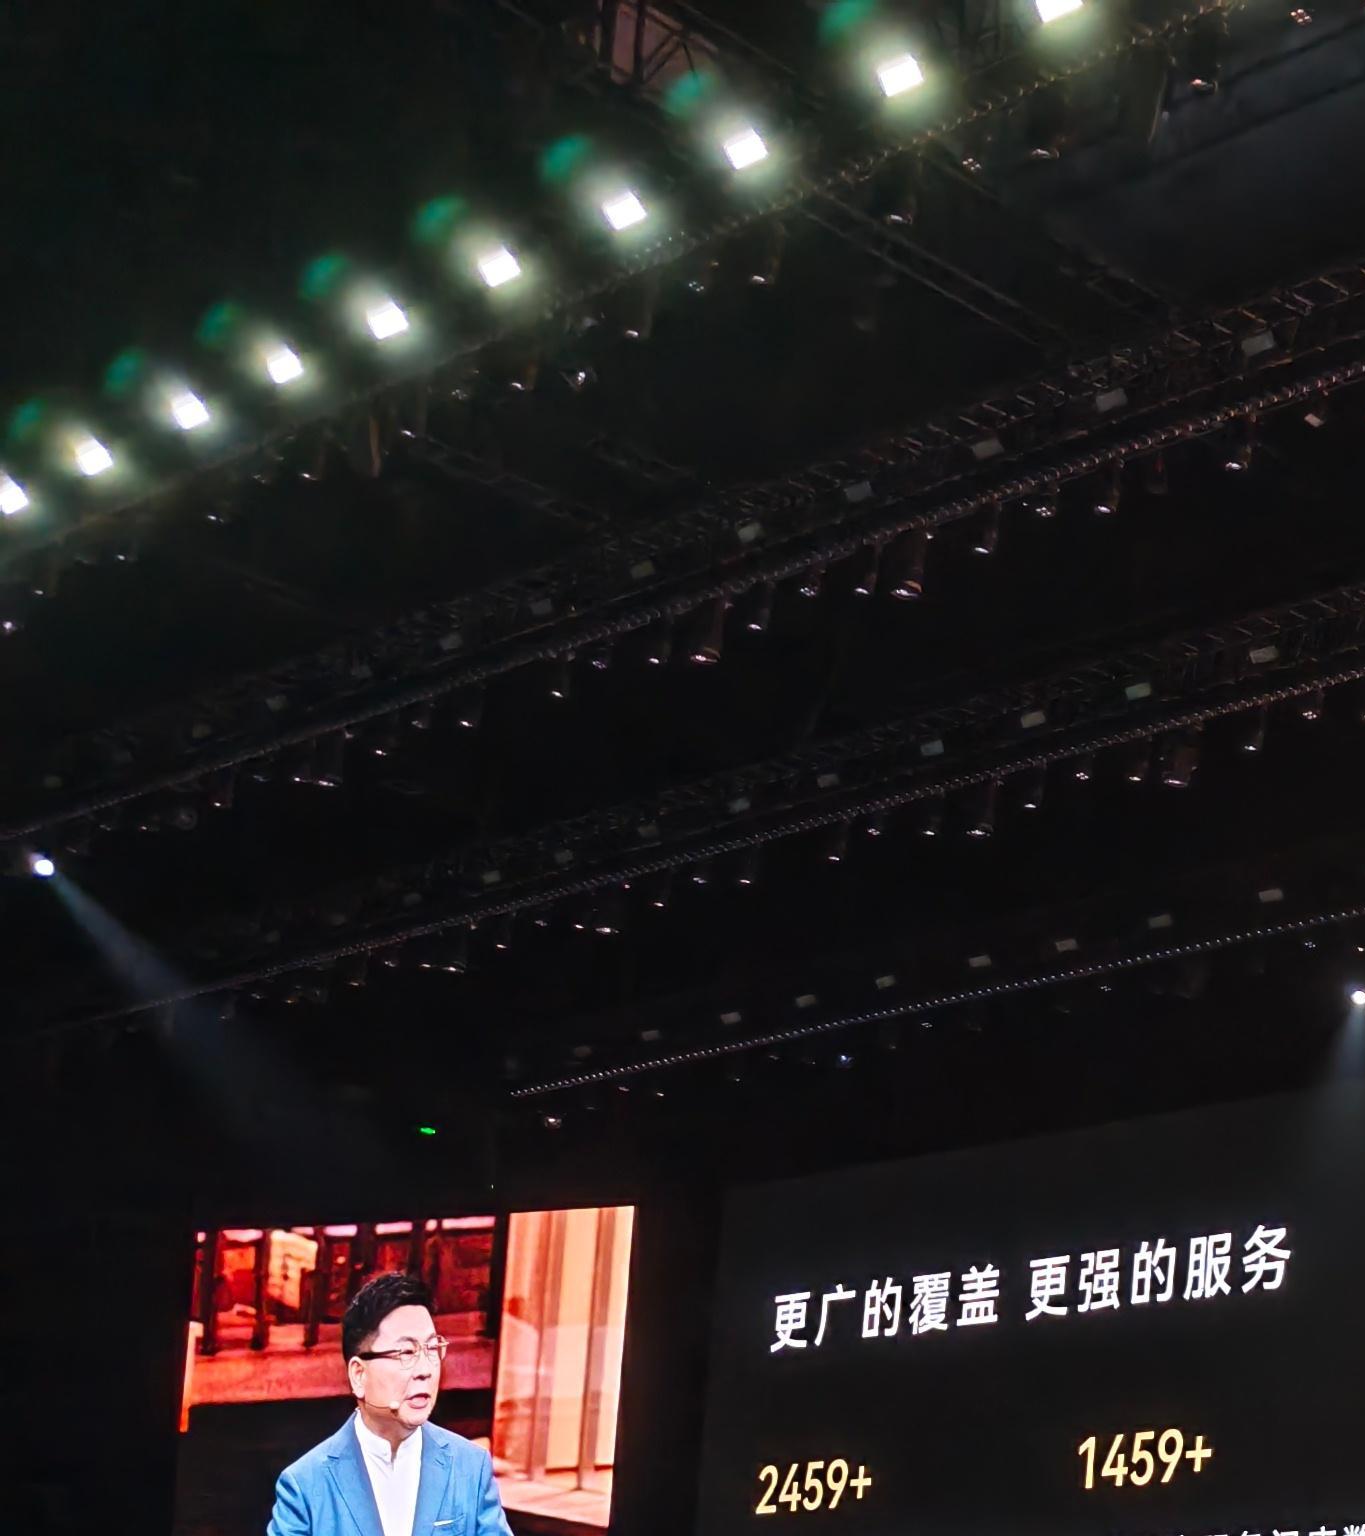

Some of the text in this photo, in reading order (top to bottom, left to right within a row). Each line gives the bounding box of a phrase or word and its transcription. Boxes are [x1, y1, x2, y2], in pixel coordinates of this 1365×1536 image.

[769, 1224, 1293, 1354] 更广的覆盖 更强的服务
[754, 1458, 873, 1516] 2459+
[1077, 1428, 1214, 1490] 1459+
